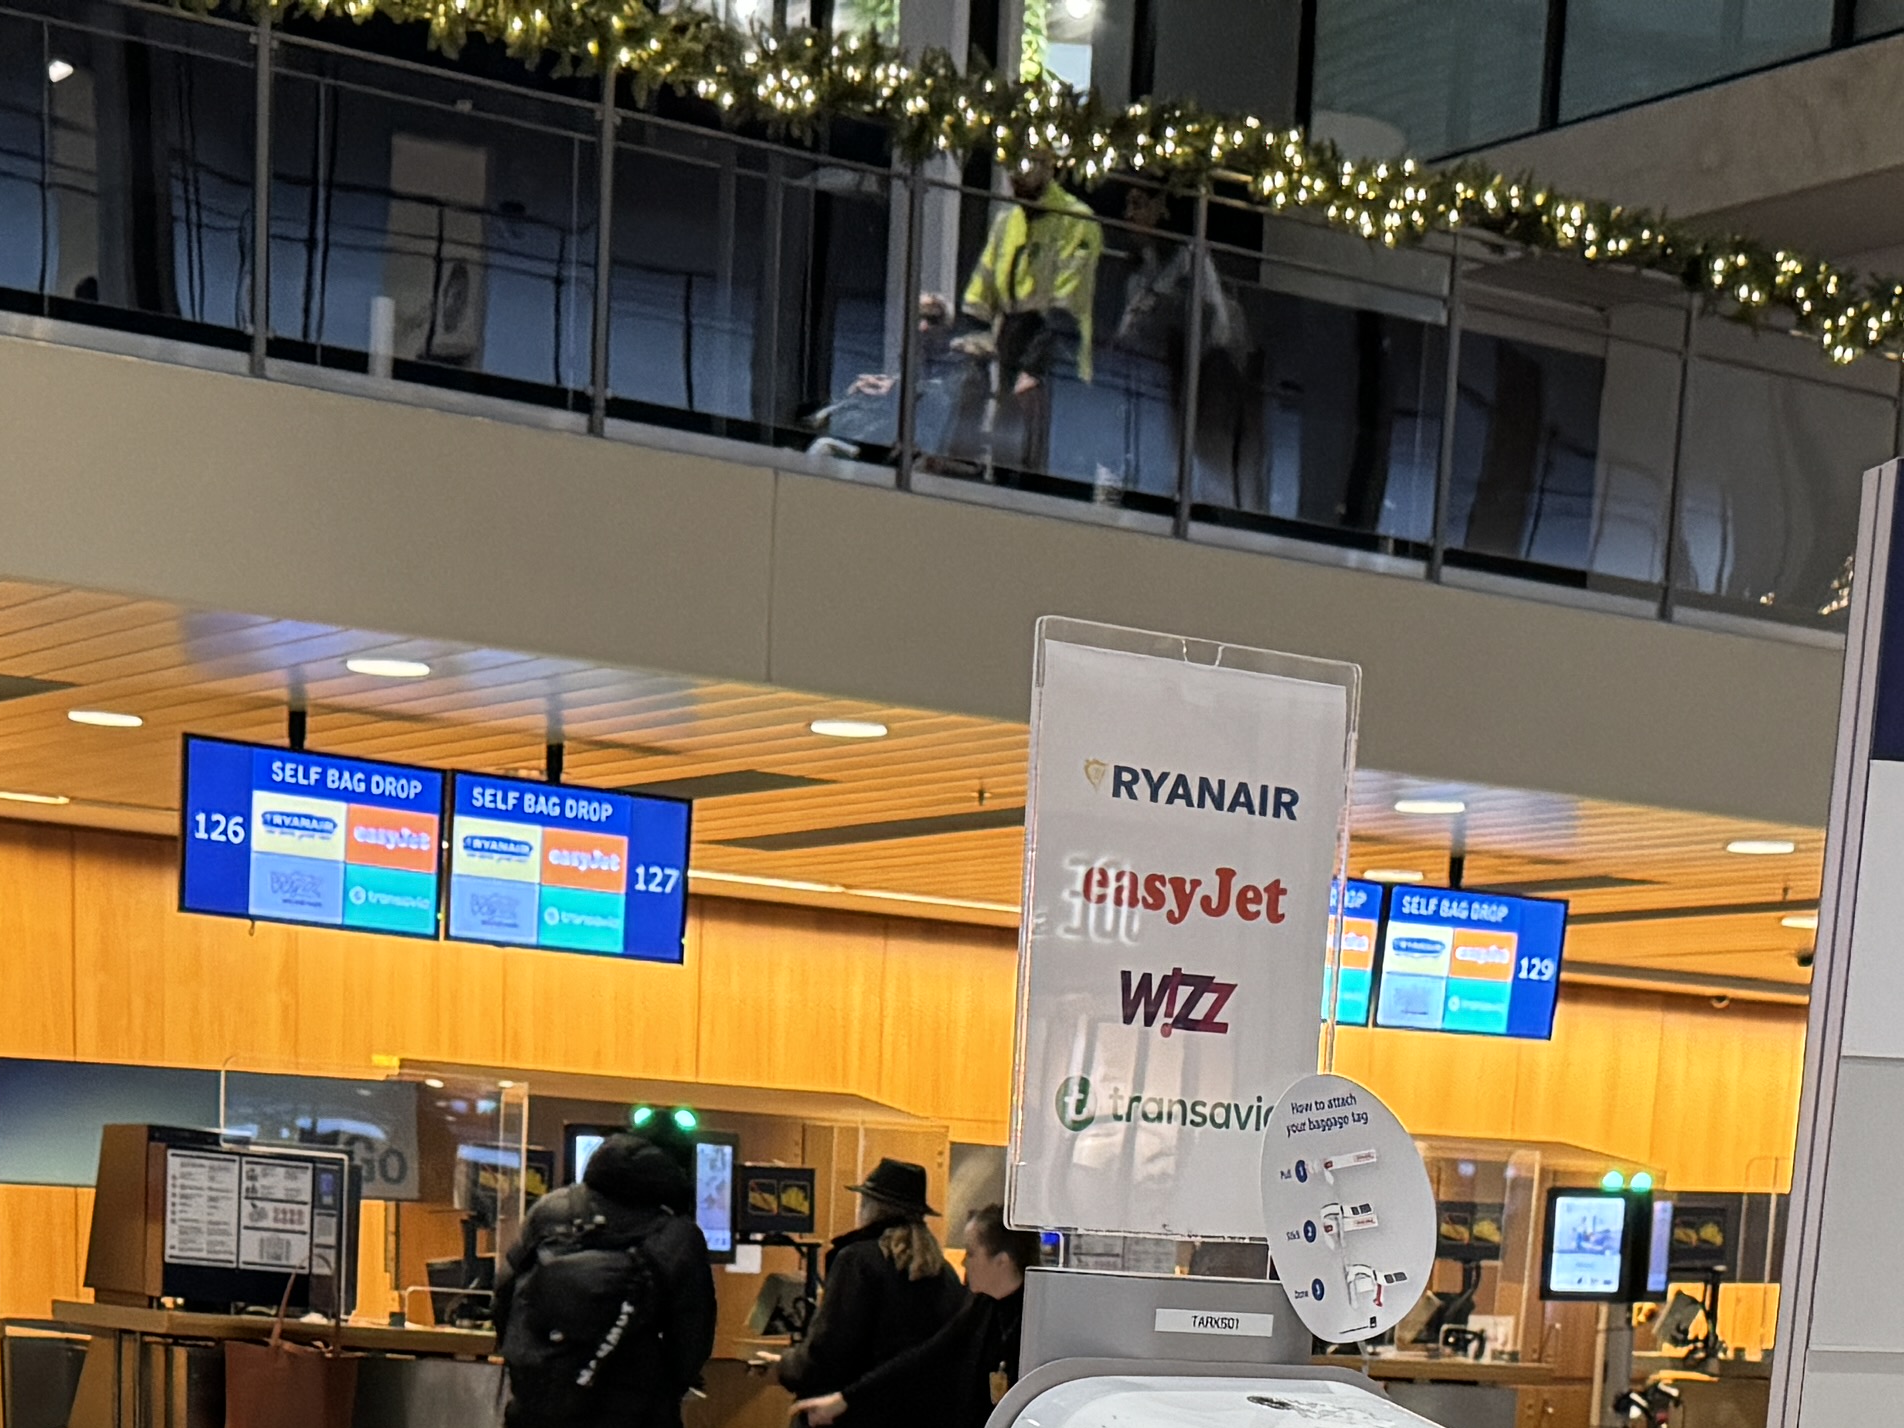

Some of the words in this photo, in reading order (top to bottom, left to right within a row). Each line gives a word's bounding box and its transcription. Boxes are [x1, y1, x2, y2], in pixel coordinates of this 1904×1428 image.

[271, 761, 322, 786] SELF
[326, 768, 366, 793] BAG
[371, 775, 423, 800] DROP
[1112, 763, 1300, 823] RYANAIR
[472, 786, 520, 811] SELF
[523, 793, 560, 816] BAG
[565, 798, 613, 822] DROP
[195, 813, 245, 845] 126
[634, 864, 680, 894] 127
[1081, 862, 1288, 925] easyJet
[1518, 957, 1555, 981] 129
